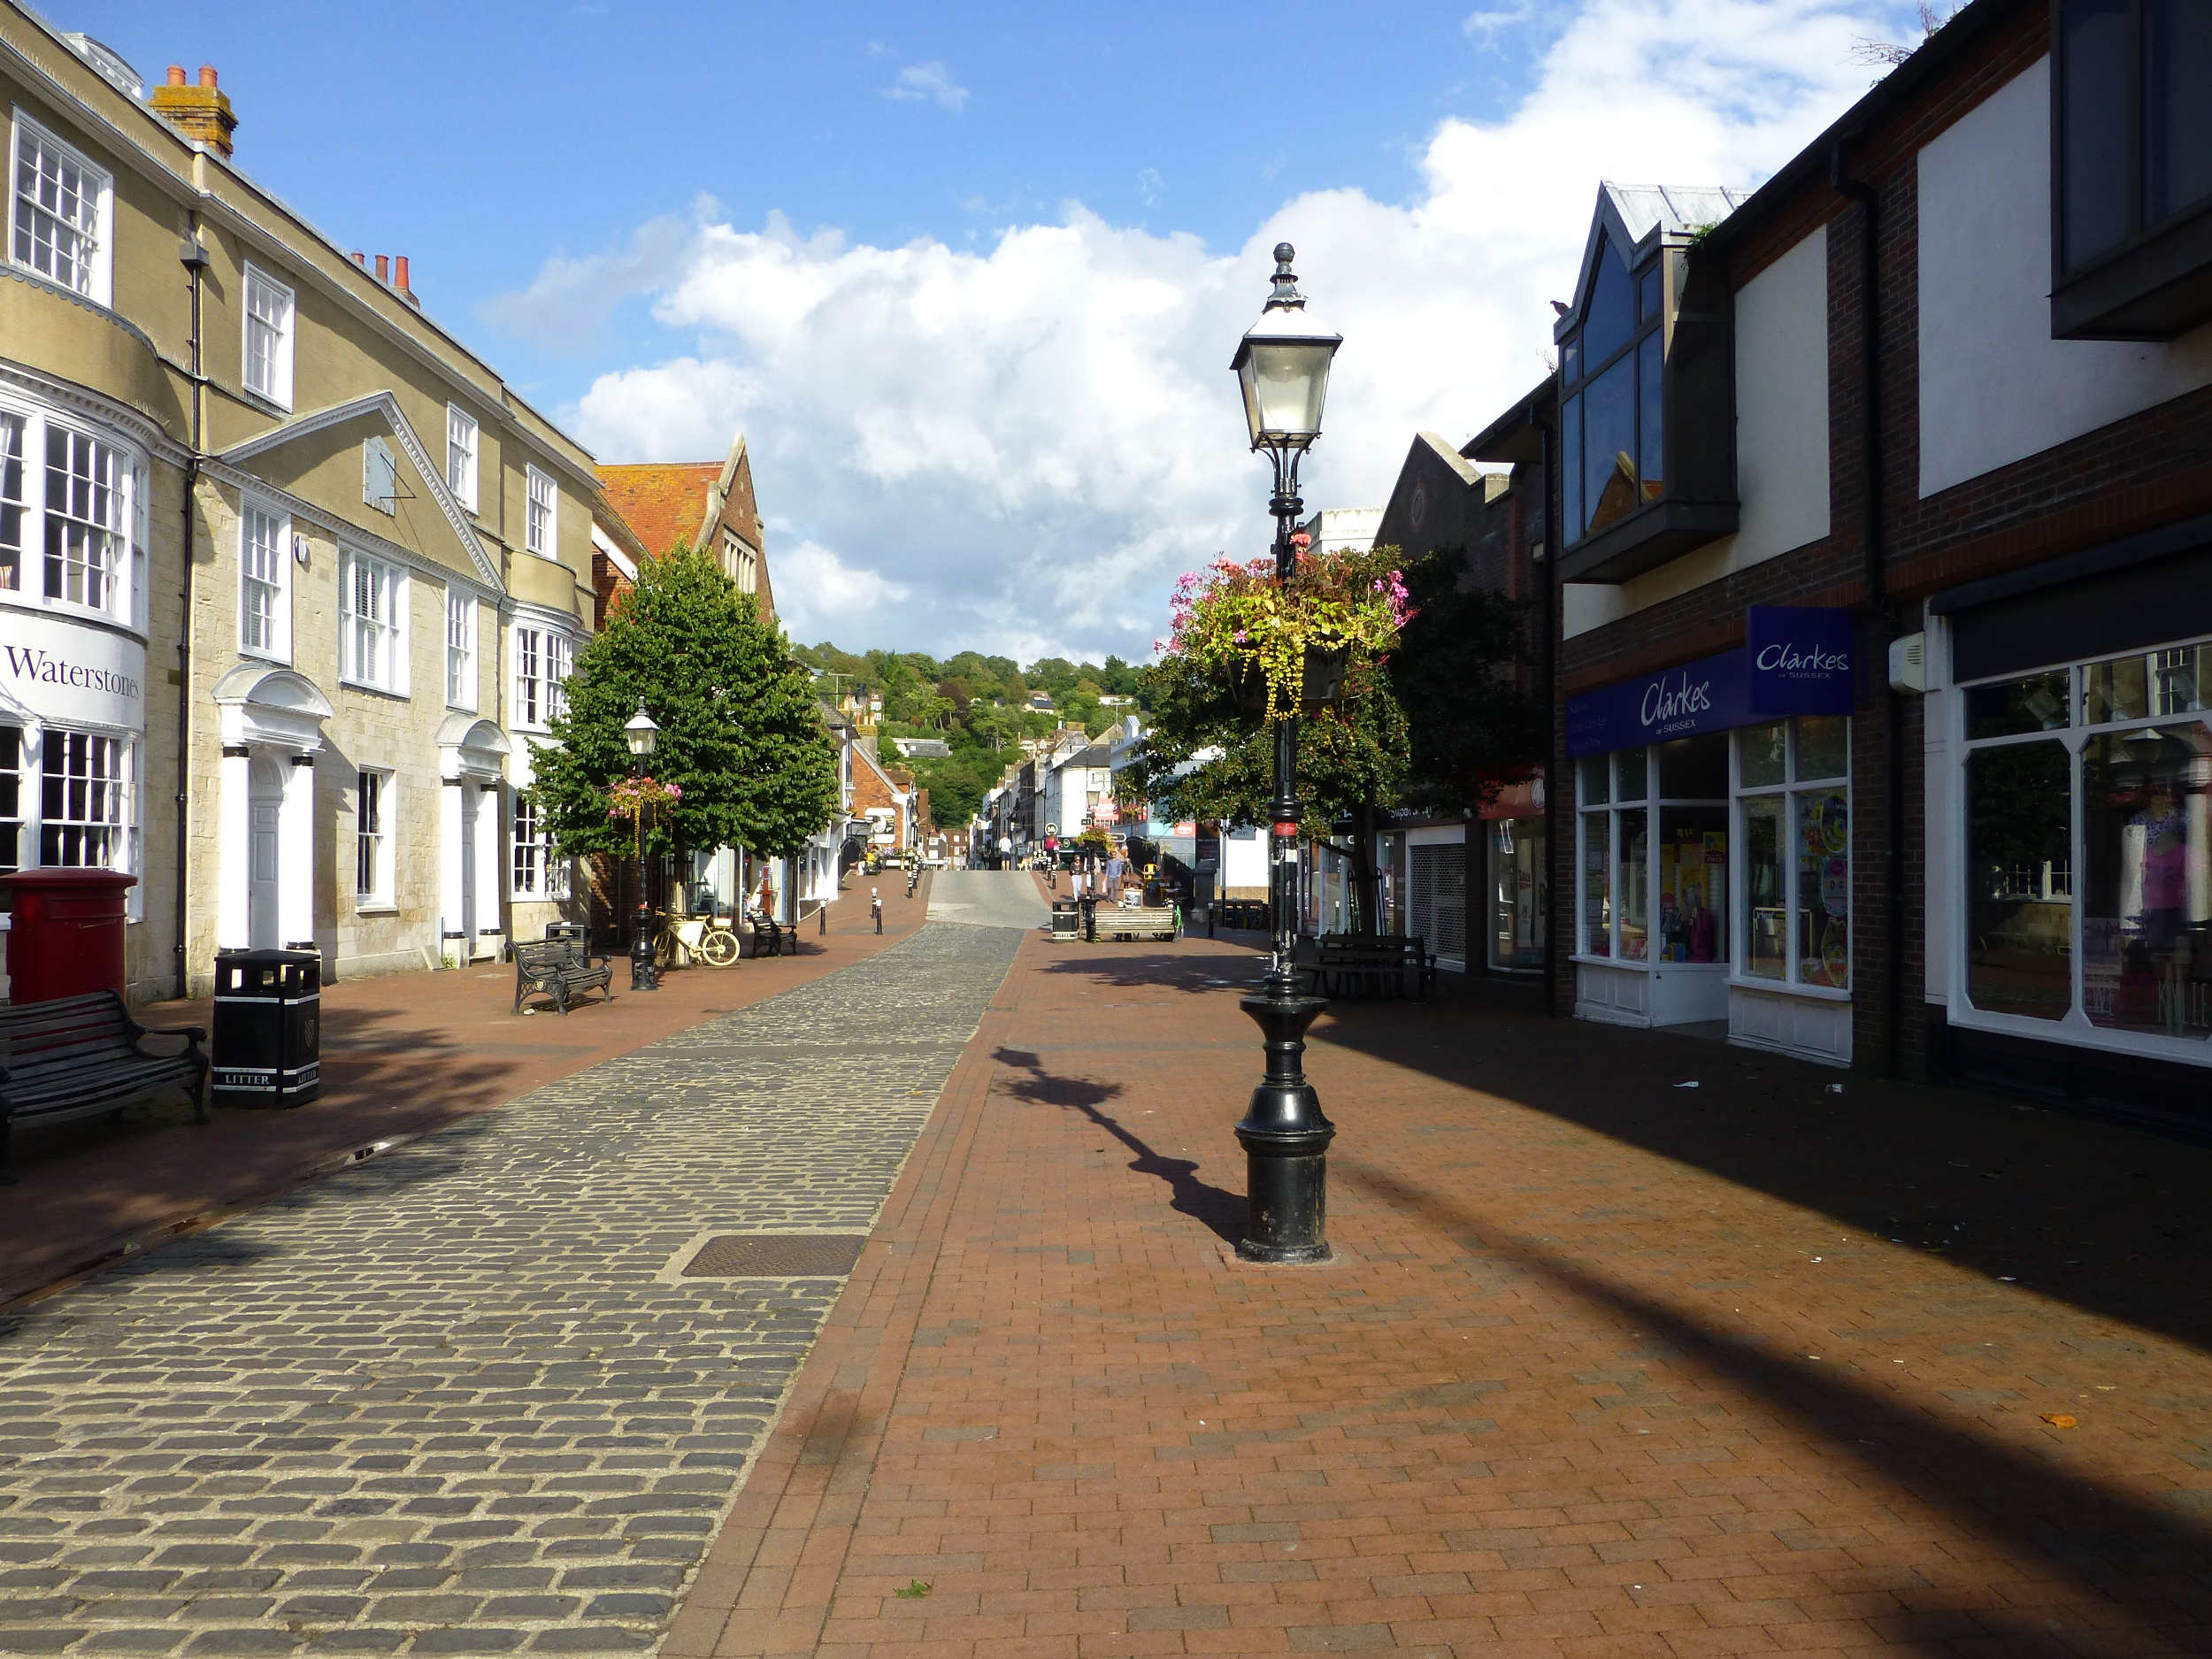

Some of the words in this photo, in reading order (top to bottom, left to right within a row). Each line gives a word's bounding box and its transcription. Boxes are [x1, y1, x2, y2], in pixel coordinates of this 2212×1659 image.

[1756, 642, 1850, 672] Clarkes
[4, 645, 140, 700] Waterstones
[1640, 672, 1711, 726] Clarkes
[1663, 718, 1697, 733] SUSSEX
[225, 1074, 270, 1085] LITTER
[297, 1069, 317, 1084] LITTER
